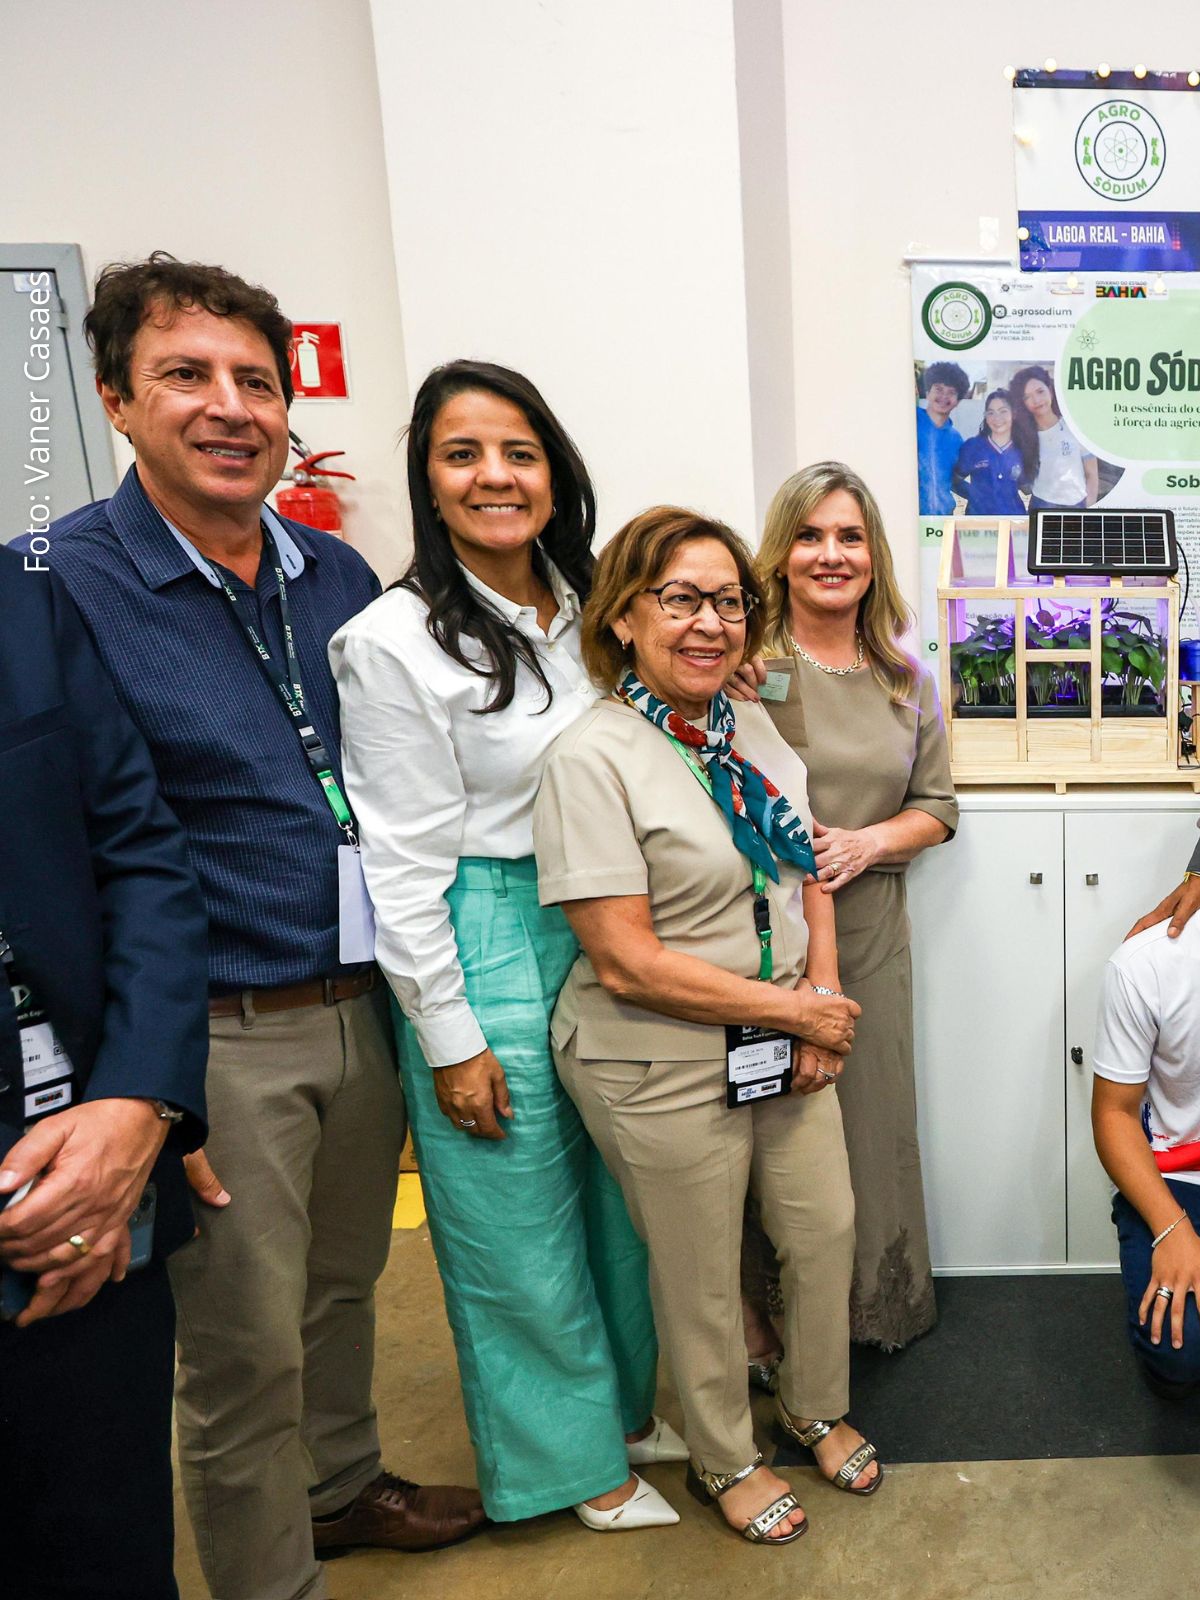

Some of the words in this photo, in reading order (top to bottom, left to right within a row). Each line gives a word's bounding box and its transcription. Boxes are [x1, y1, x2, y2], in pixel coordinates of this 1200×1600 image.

[1098, 105, 1140, 122] AGRO
[1093, 176, 1148, 194] SÓDIUM
[1049, 226, 1086, 243] LAGOA
[1090, 226, 1118, 243] REAL
[1131, 226, 1165, 243] BAHIA
[944, 292, 968, 302] AGRO
[1096, 286, 1147, 298] BAHIA
[1068, 356, 1140, 391] AGRO
[1114, 404, 1128, 413] Da
[1131, 403, 1177, 413] essência
[1180, 404, 1193, 413] do
[1114, 416, 1119, 426] à
[1122, 417, 1151, 428] força
[1154, 418, 1167, 427] da
[926, 528, 943, 537] Po
[287, 700, 302, 717] BTX
